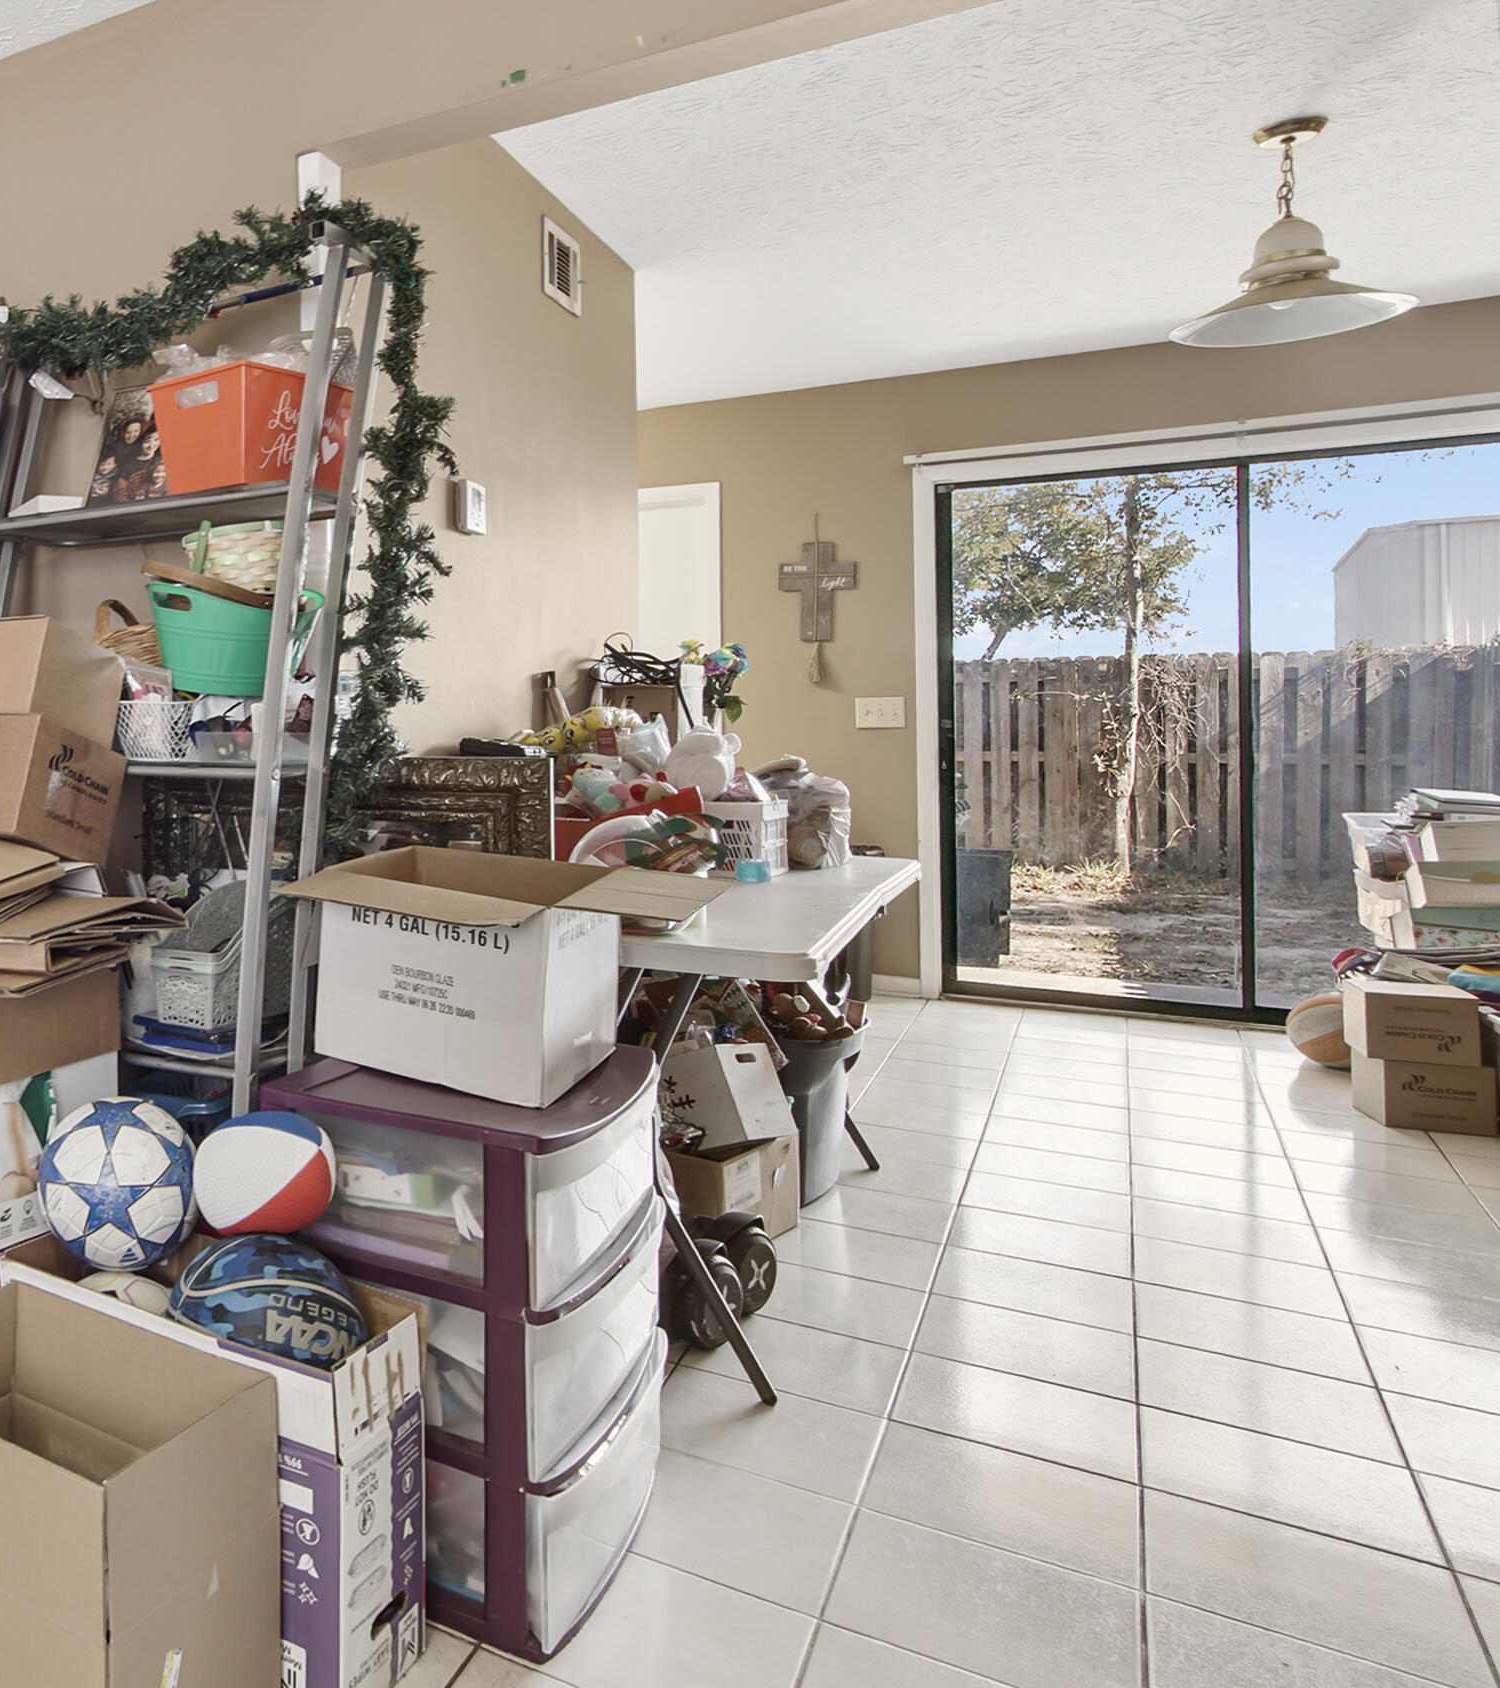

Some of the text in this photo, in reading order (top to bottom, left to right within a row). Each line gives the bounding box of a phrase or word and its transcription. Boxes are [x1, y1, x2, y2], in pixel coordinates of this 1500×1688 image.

[268, 390, 301, 430] Lov
[793, 564, 807, 572] THE
[351, 906, 510, 955] NET 4 GAL (15.16 L)
[265, 1308, 357, 1361] NCAA
